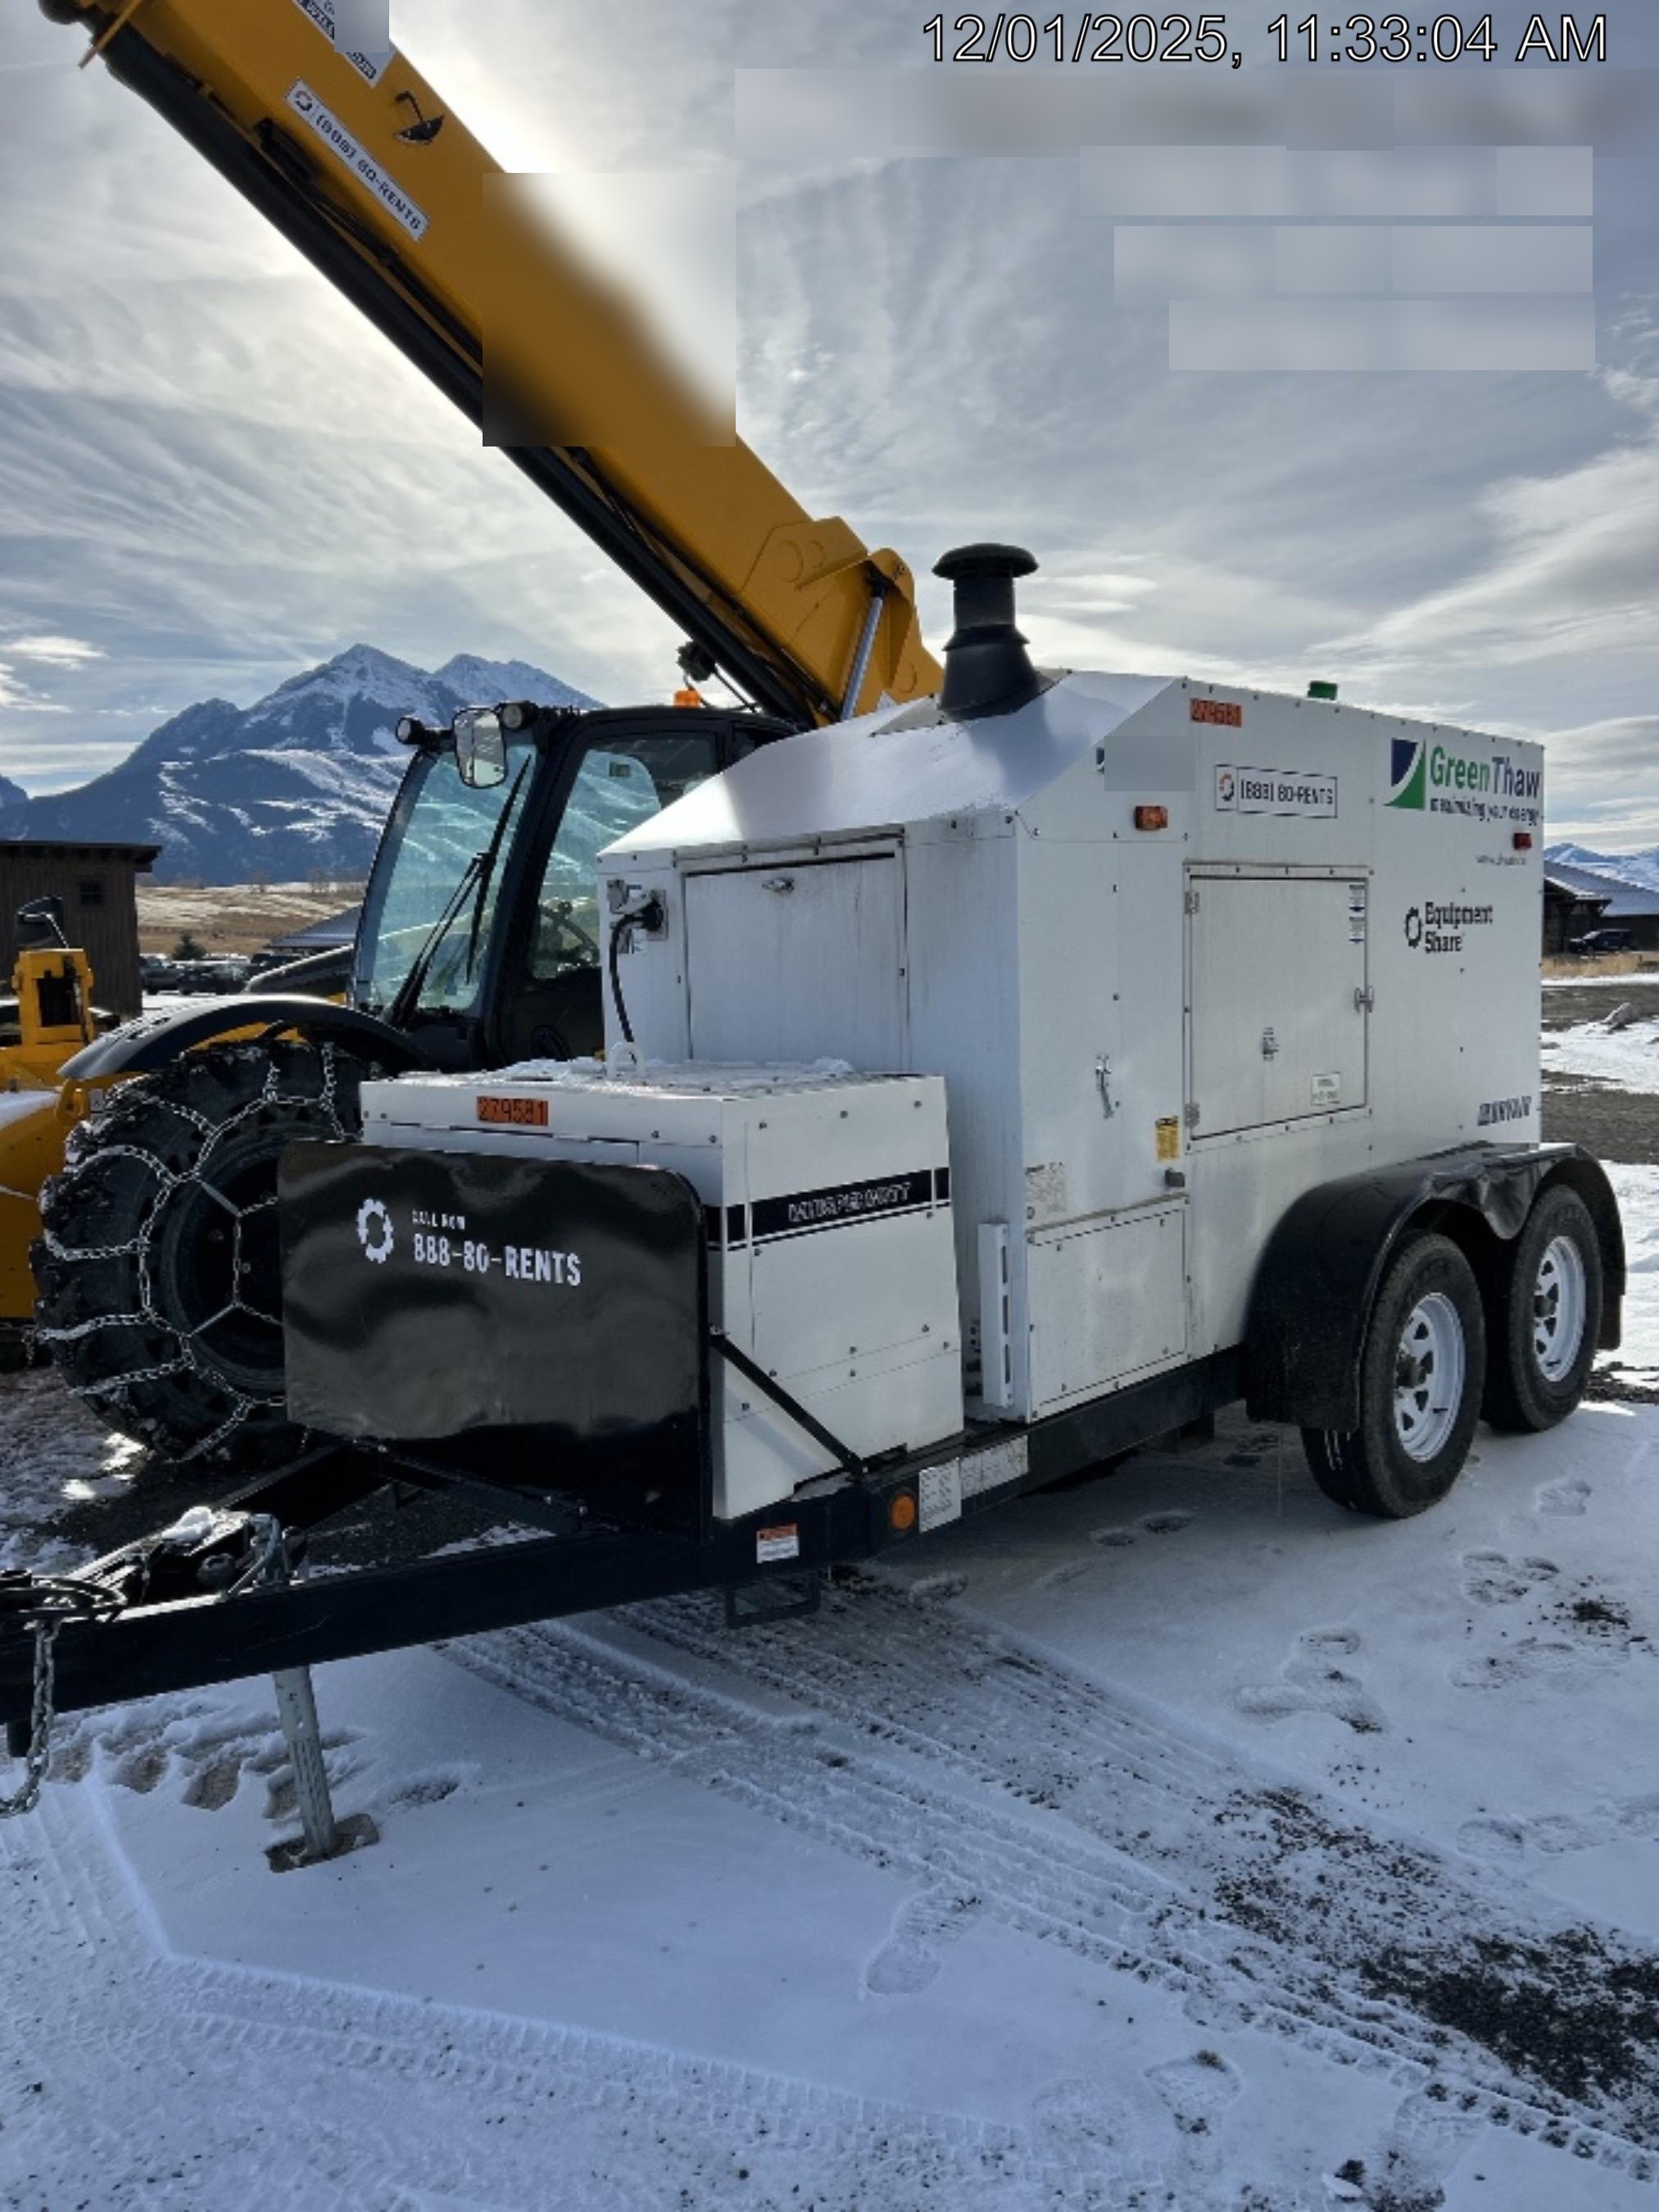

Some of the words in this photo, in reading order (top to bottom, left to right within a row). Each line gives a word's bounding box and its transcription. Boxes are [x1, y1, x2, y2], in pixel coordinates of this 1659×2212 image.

[1426, 902, 1493, 929] Equipment
[1426, 931, 1462, 953] Share
[414, 1233, 582, 1286] 888-80-RENTS
